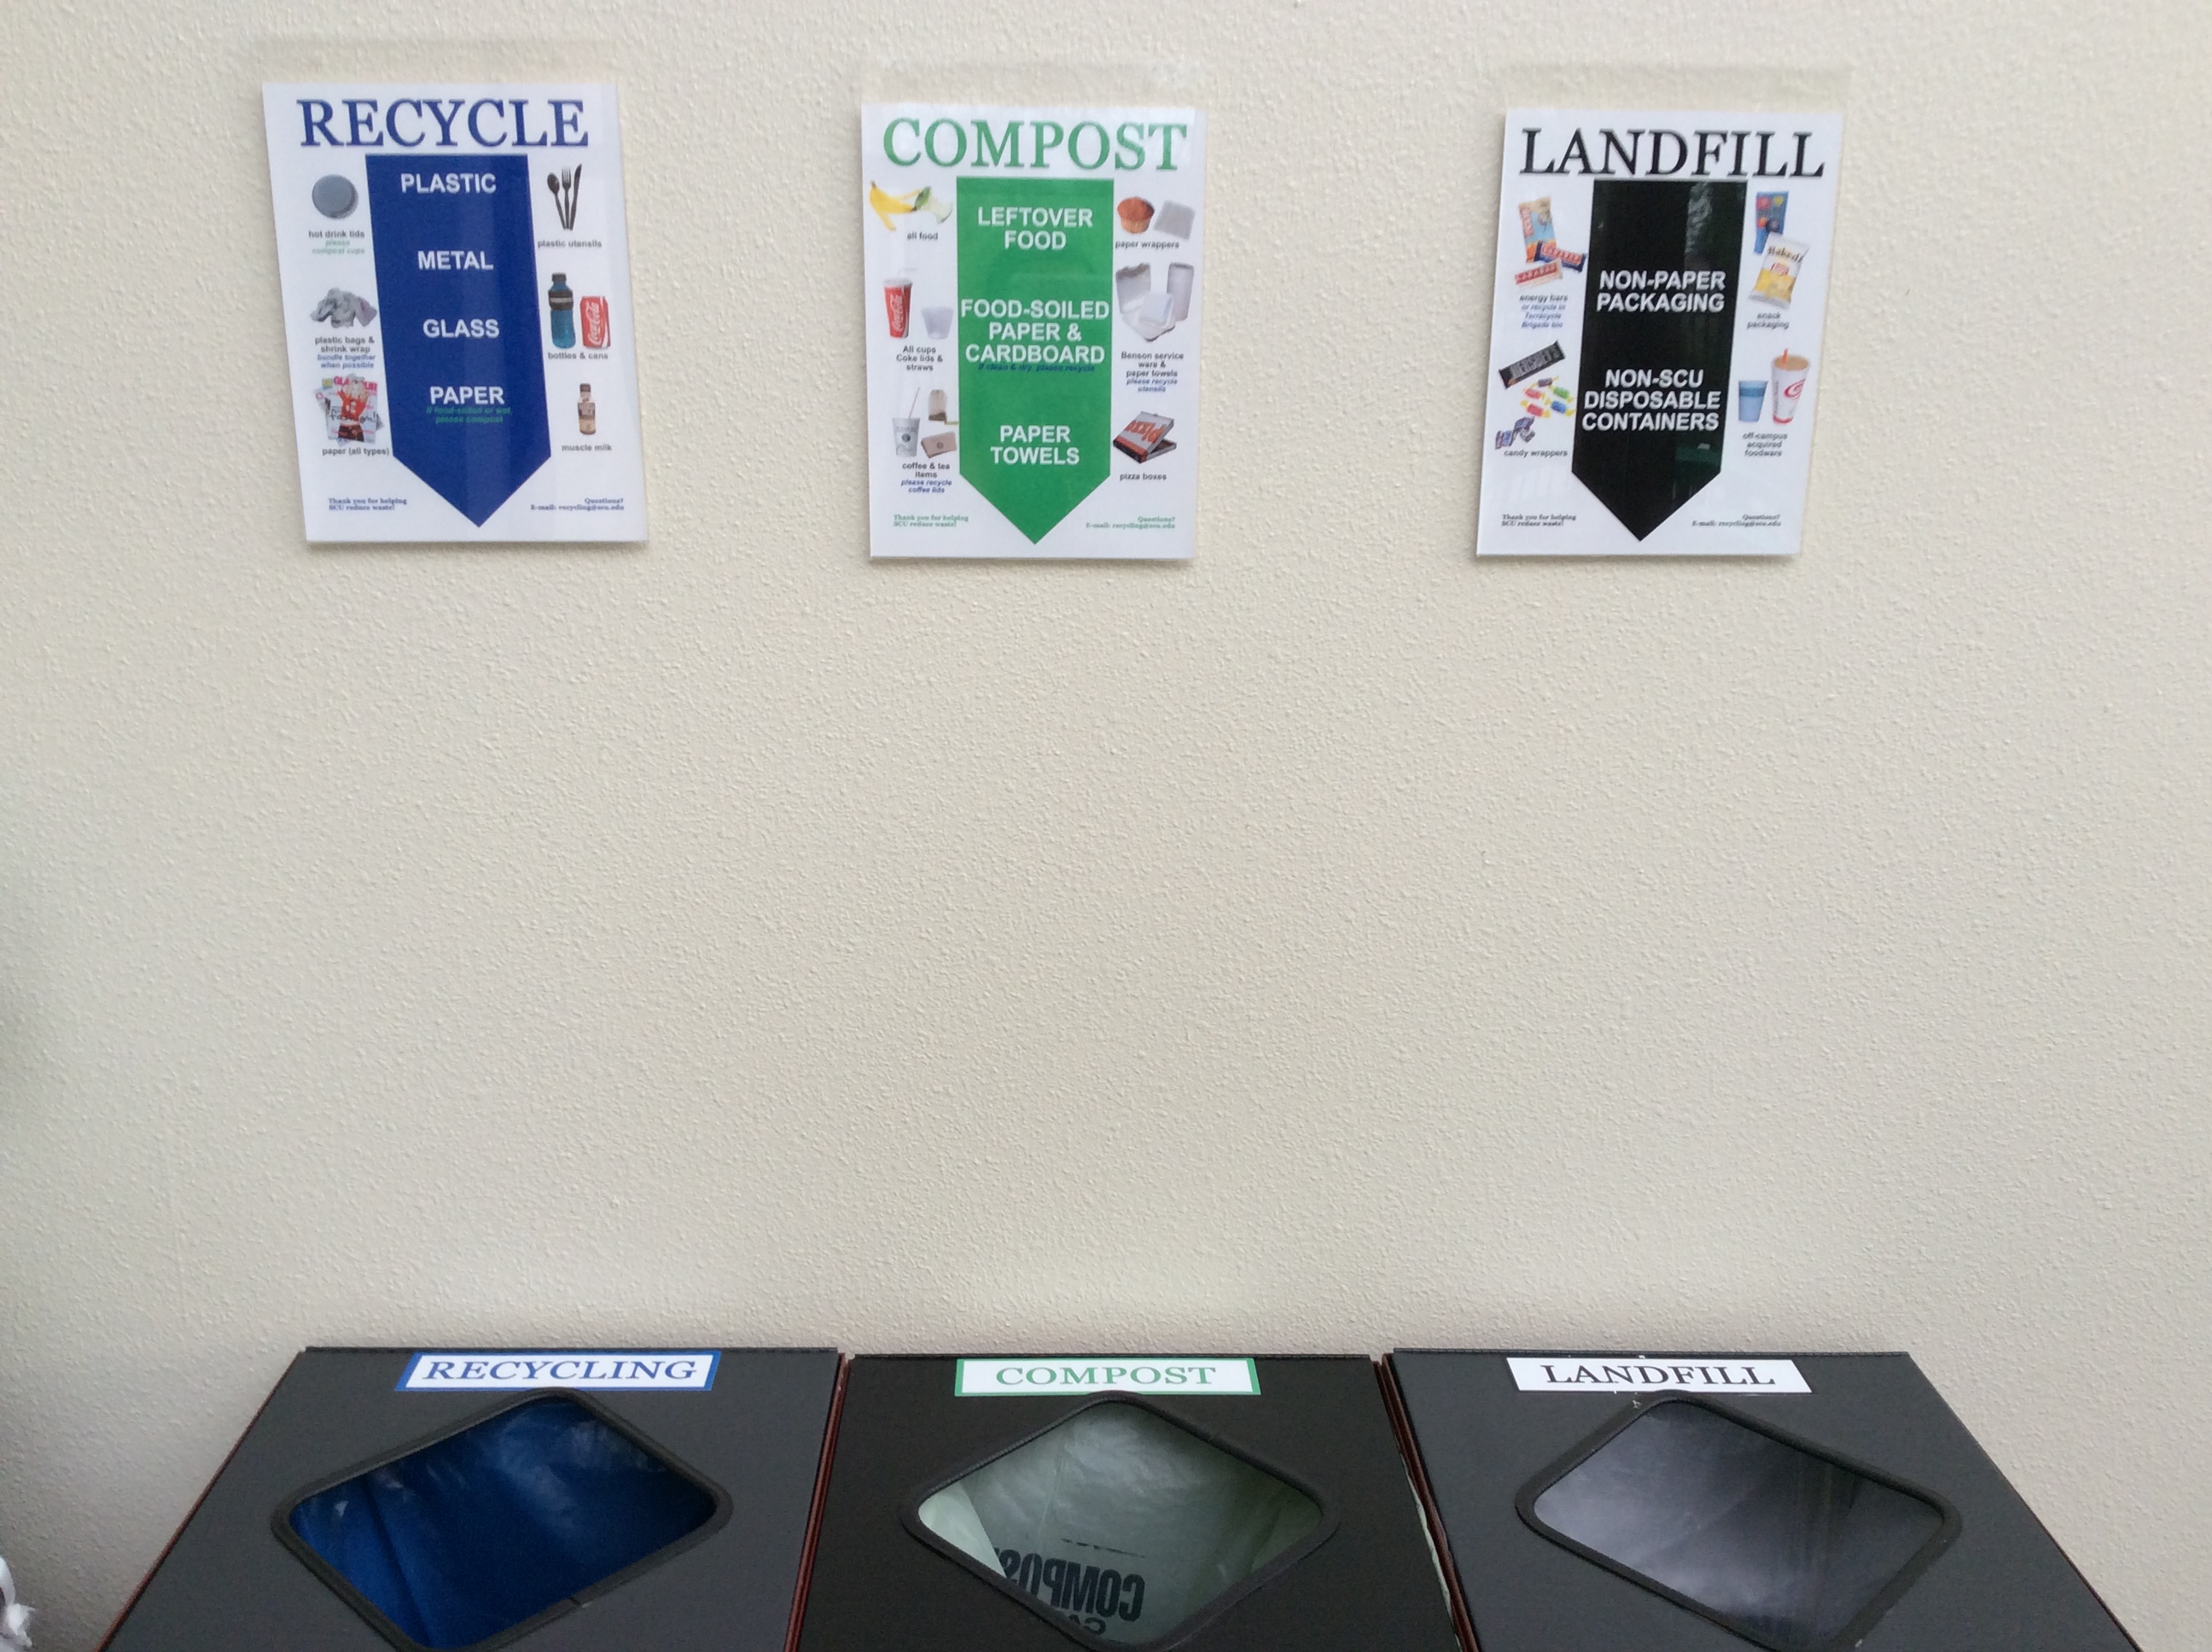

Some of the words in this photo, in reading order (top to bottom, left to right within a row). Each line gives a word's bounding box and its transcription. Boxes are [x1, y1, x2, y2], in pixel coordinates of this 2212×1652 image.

[296, 98, 589, 148] RECYCLE
[883, 117, 1187, 171] COMPOST
[1519, 128, 1825, 177] LANDFILL
[401, 173, 497, 193] PLASTIC
[977, 206, 1093, 228] LEFTOVER
[308, 230, 323, 238] hot
[324, 230, 346, 238] drink
[349, 230, 365, 238] lids
[538, 239, 567, 248] plastic
[568, 239, 602, 247] utensils
[906, 231, 917, 240] all
[919, 231, 939, 240] food
[1004, 230, 1068, 250] FOOD
[1115, 241, 1138, 250] paper
[1141, 241, 1179, 250] wrappers
[417, 250, 494, 270] METAL
[1599, 270, 1726, 291] NON-PAPER
[961, 299, 1109, 320] FOOD-SOILED
[1596, 293, 1725, 312] PACKAGING
[422, 318, 500, 338] GLASS
[989, 322, 1061, 341] PAPER
[1067, 323, 1082, 341] &
[1747, 321, 1790, 330] packaging
[314, 336, 342, 346] plastic
[345, 335, 366, 345] bags
[368, 335, 375, 344] &
[350, 346, 370, 354] wrap
[548, 351, 577, 359] bottles
[937, 354, 943, 363] &
[965, 344, 1105, 364] CARDBOARD
[1121, 351, 1152, 359] Benson
[906, 363, 934, 371] straws
[1036, 364, 1063, 372] please
[1065, 364, 1095, 373] recycle
[1126, 369, 1150, 378] paper
[1605, 369, 1703, 388] NON-SCU
[429, 386, 505, 405] PAPER
[1584, 391, 1721, 410] DISPOSABLE
[1581, 412, 1720, 431] CONTAINERS
[999, 425, 1071, 443] PAPER
[1743, 432, 1788, 440] off-campus
[322, 448, 346, 457] paper
[348, 447, 361, 457] (all
[364, 447, 390, 457] types)
[990, 446, 1080, 465] TOWELS
[1504, 450, 1528, 458] candy
[902, 462, 927, 470] coffee
[901, 479, 925, 487] please
[926, 479, 952, 487] recycle
[1120, 472, 1140, 481] pizza
[1143, 472, 1167, 480] boxes
[422, 1360, 697, 1379] RECYCLING
[996, 1366, 1216, 1385] COMPOST
[1540, 1365, 1775, 1385] LANDFILL
